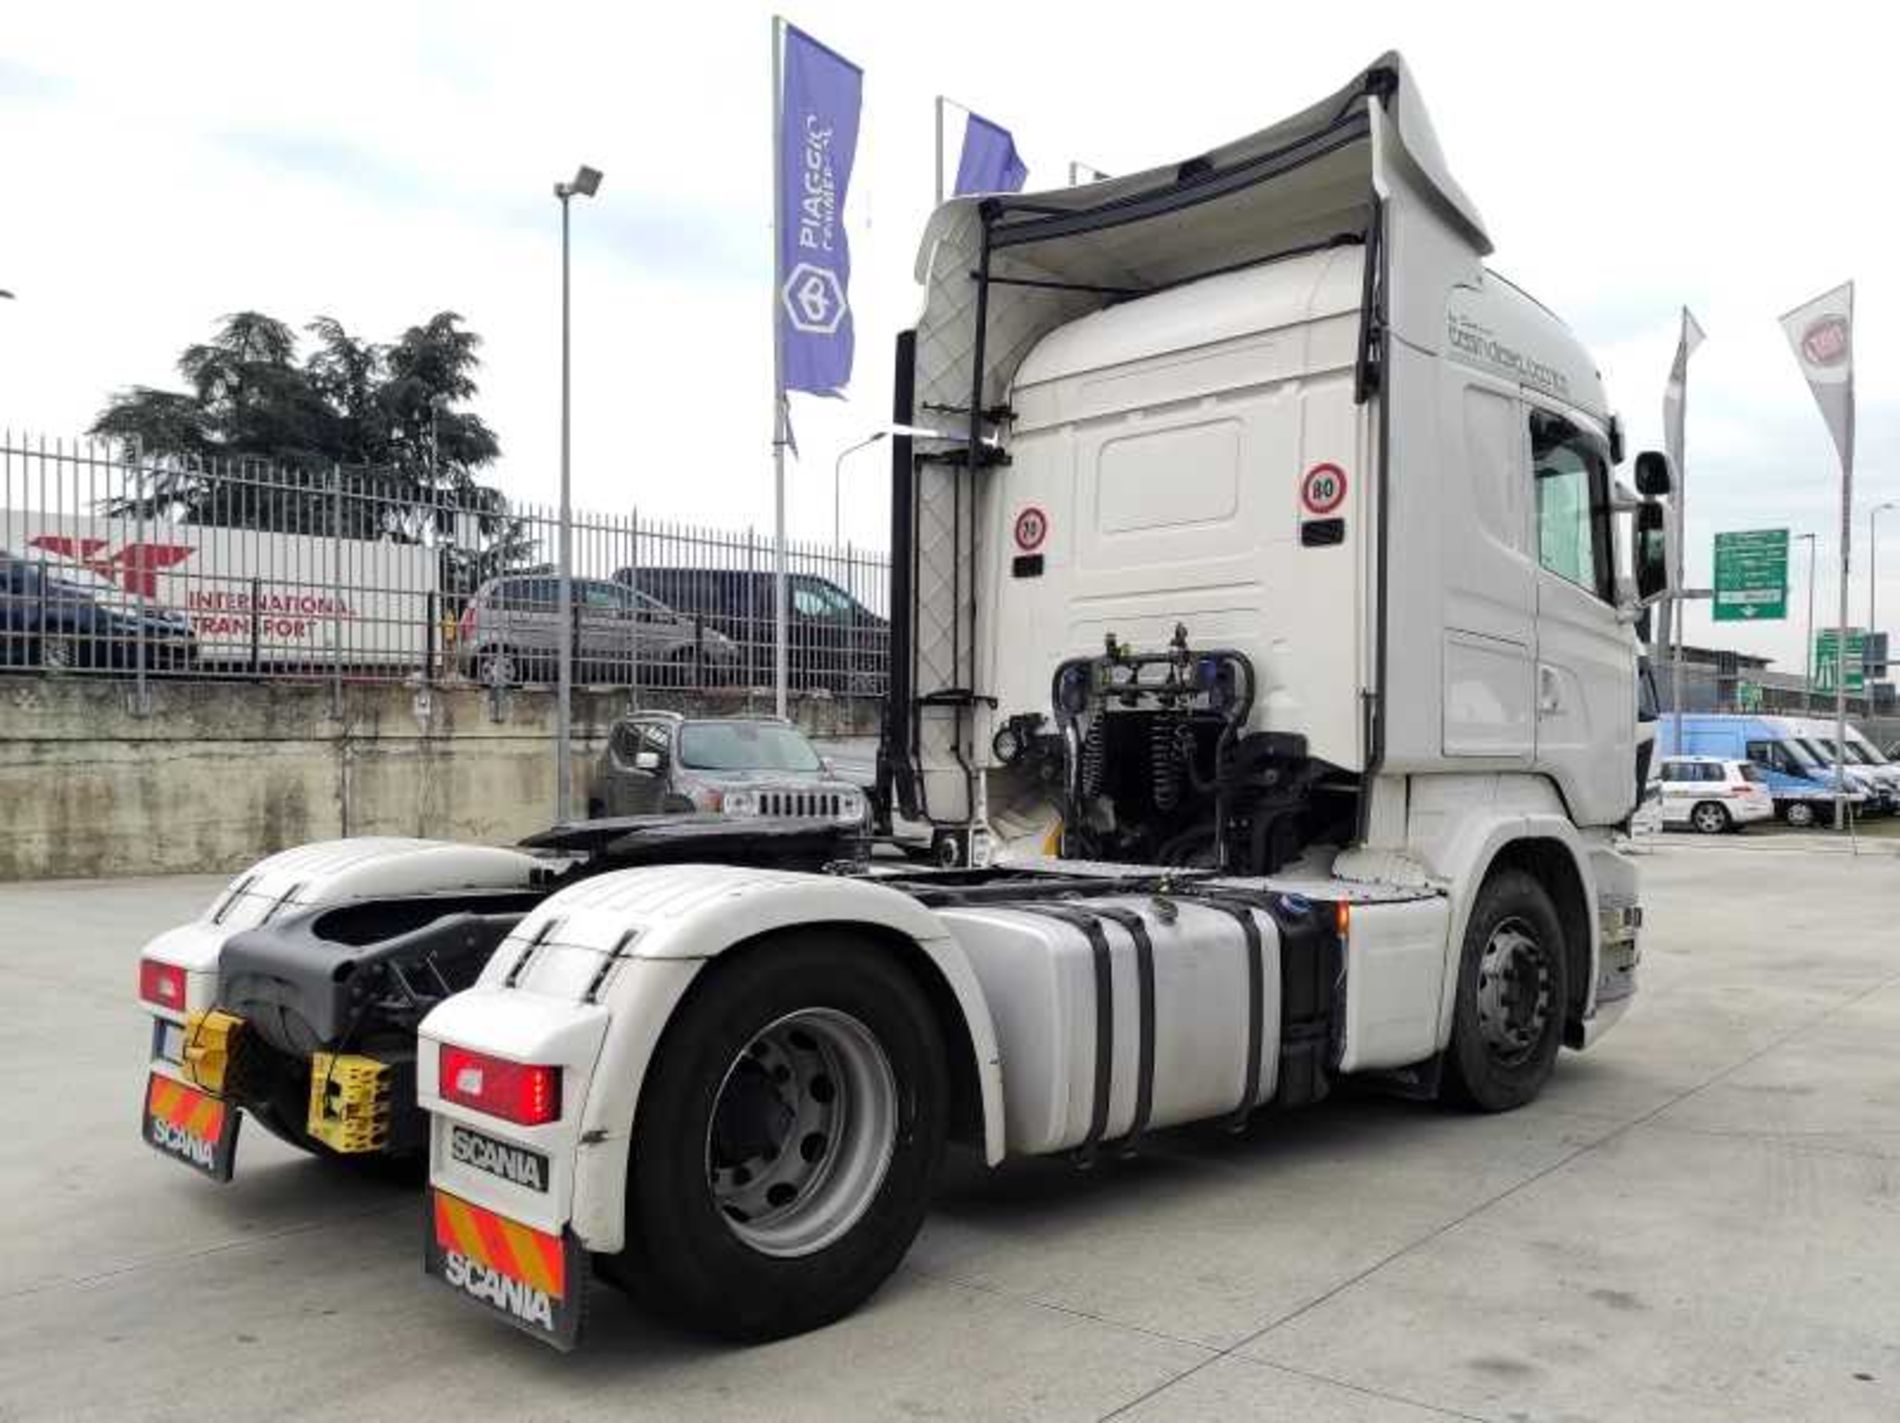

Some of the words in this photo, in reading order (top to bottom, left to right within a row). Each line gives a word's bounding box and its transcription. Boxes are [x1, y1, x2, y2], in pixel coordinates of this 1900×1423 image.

[1312, 477, 1334, 500] 80
[192, 616, 317, 637] TRANPORT
[154, 1118, 215, 1169] SCANIA
[453, 1128, 542, 1190] SCANIA
[445, 1251, 554, 1331] SCANIA
